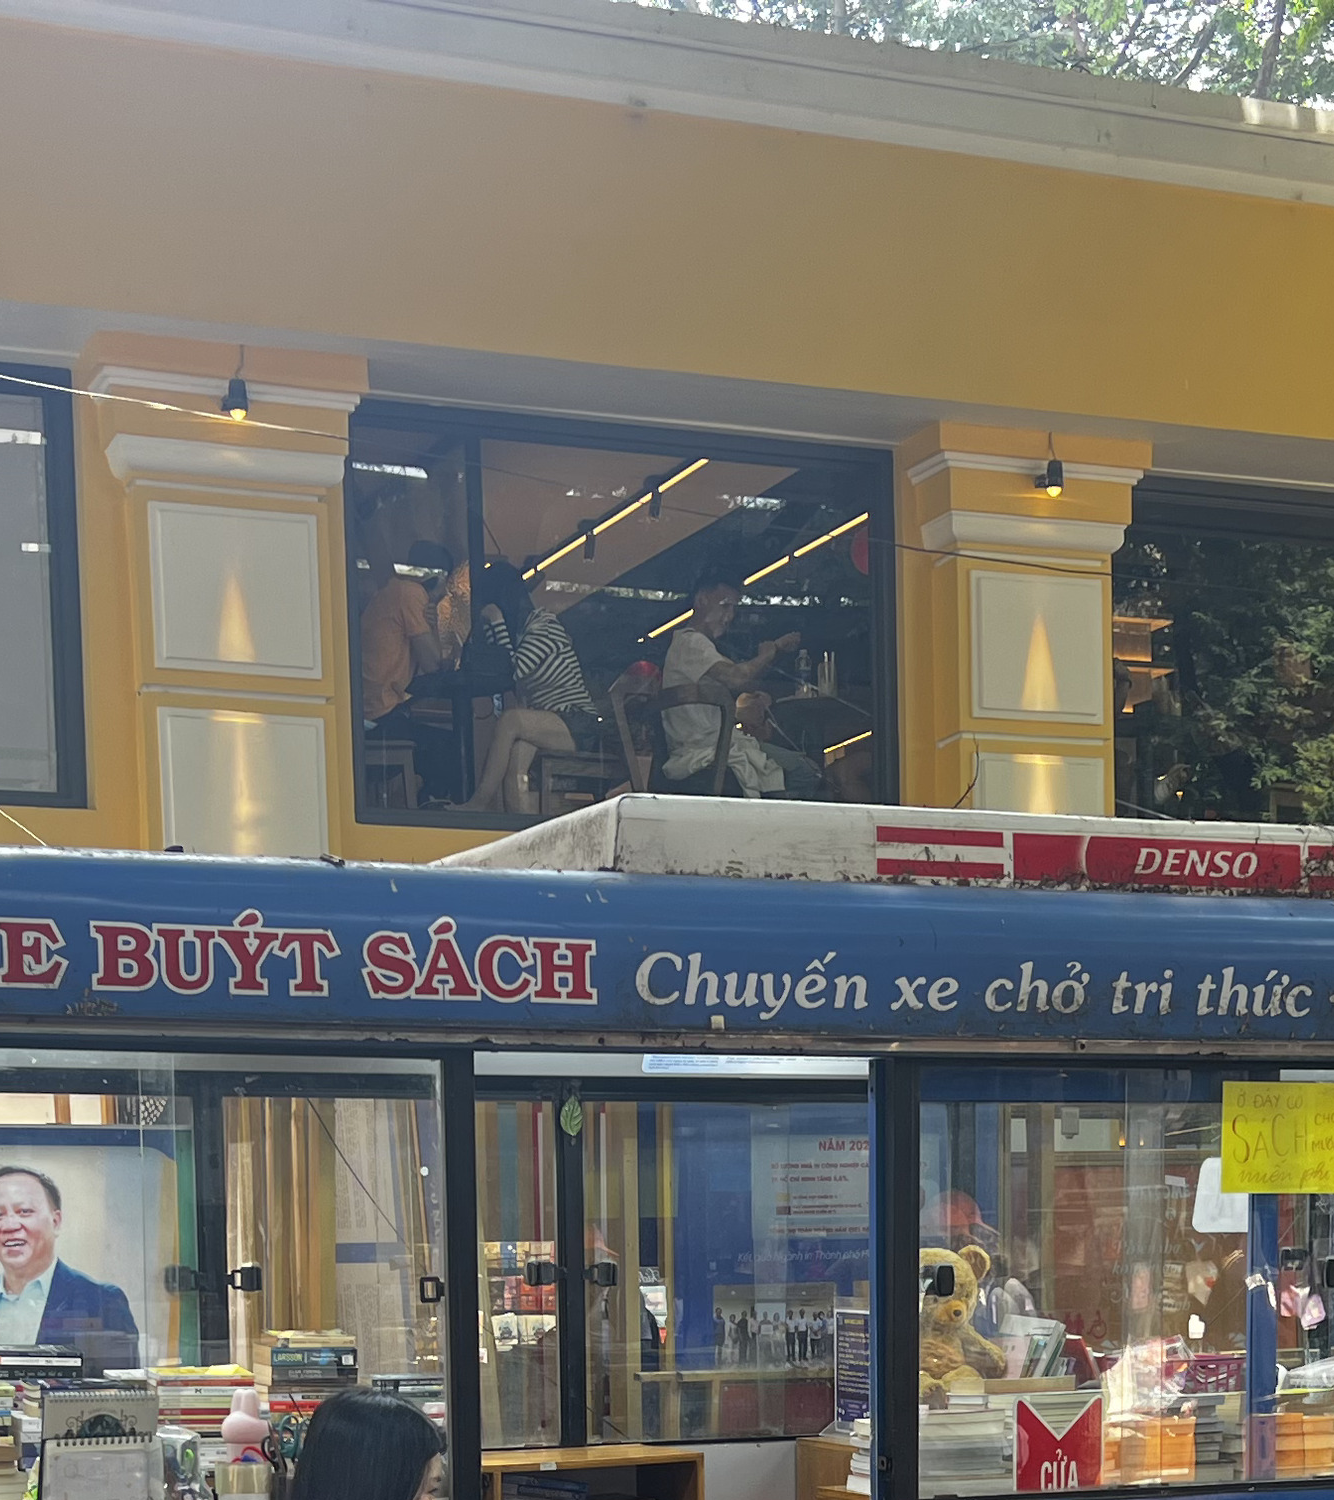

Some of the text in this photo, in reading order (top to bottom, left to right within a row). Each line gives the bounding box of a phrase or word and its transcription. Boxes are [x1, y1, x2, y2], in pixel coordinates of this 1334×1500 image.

[1133, 846, 1259, 880] DENSO
[89, 907, 342, 998] BUÝT
[361, 914, 599, 1006] SÁCH
[635, 951, 868, 1020] Chuyến
[890, 974, 959, 1012] xe
[984, 961, 1089, 1014] chở
[1110, 967, 1173, 1015] tri
[1196, 965, 1313, 1019] thức
[849, 1140, 869, 1151] 202
[1232, 1113, 1308, 1164] SÁCH
